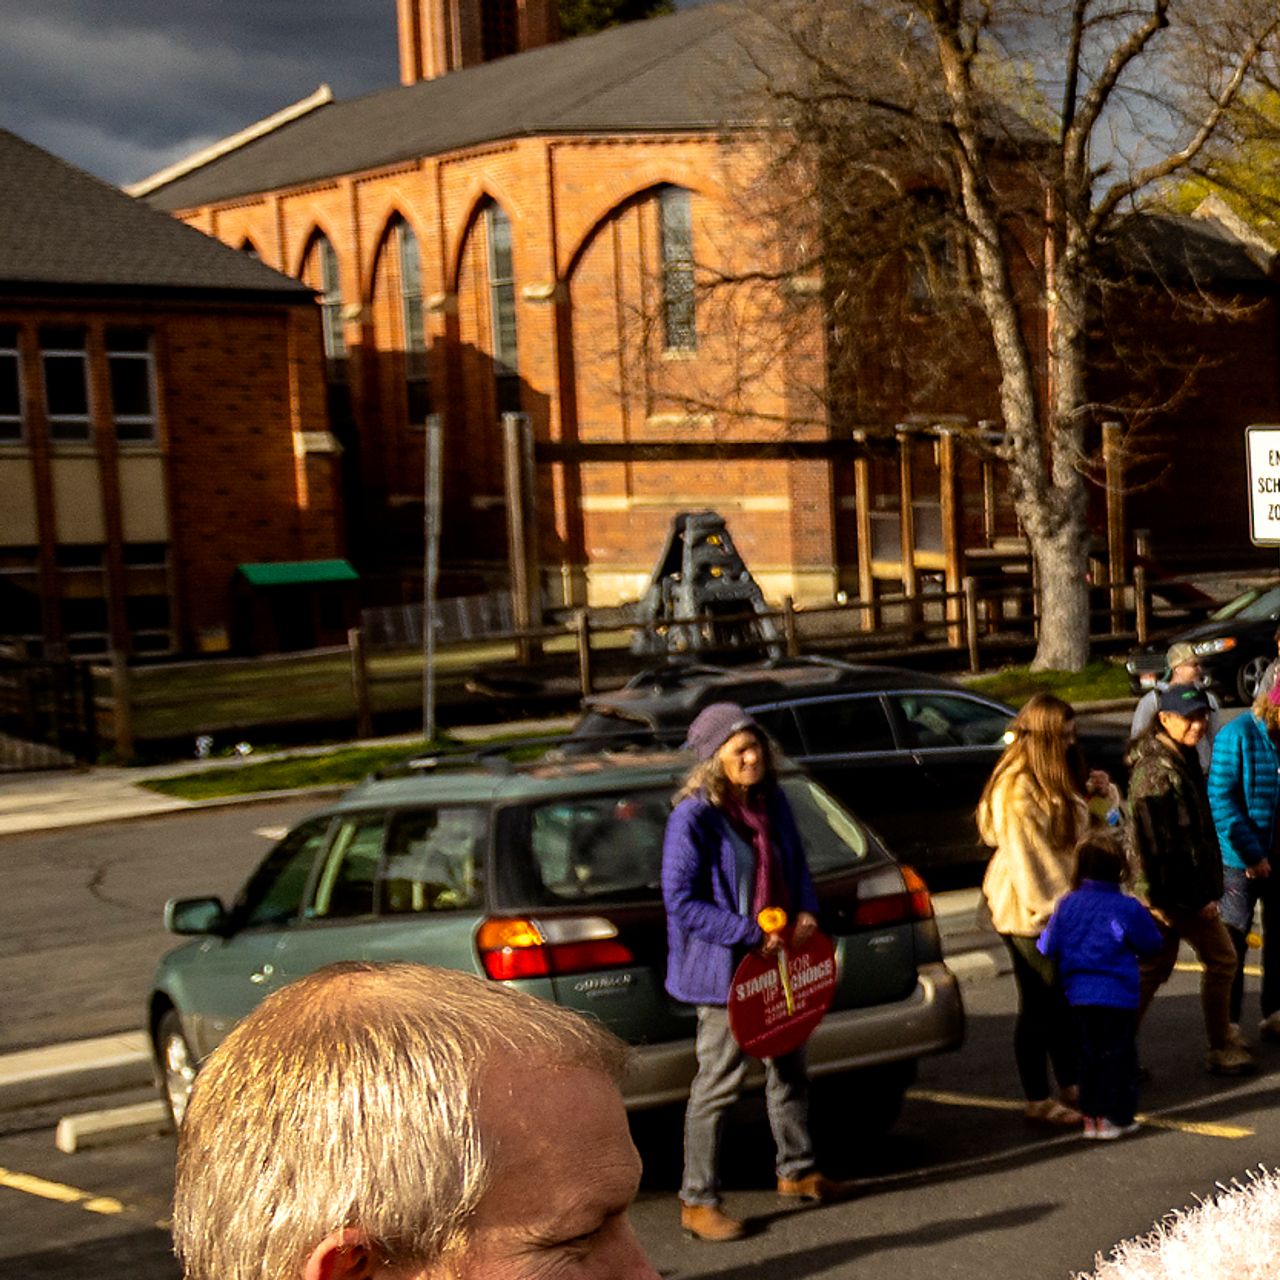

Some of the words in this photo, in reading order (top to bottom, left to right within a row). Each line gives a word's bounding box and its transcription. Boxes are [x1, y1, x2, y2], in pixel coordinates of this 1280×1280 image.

[788, 953, 810, 976] FOR
[791, 957, 834, 992] CHOICE
[735, 968, 778, 1002] STAND
